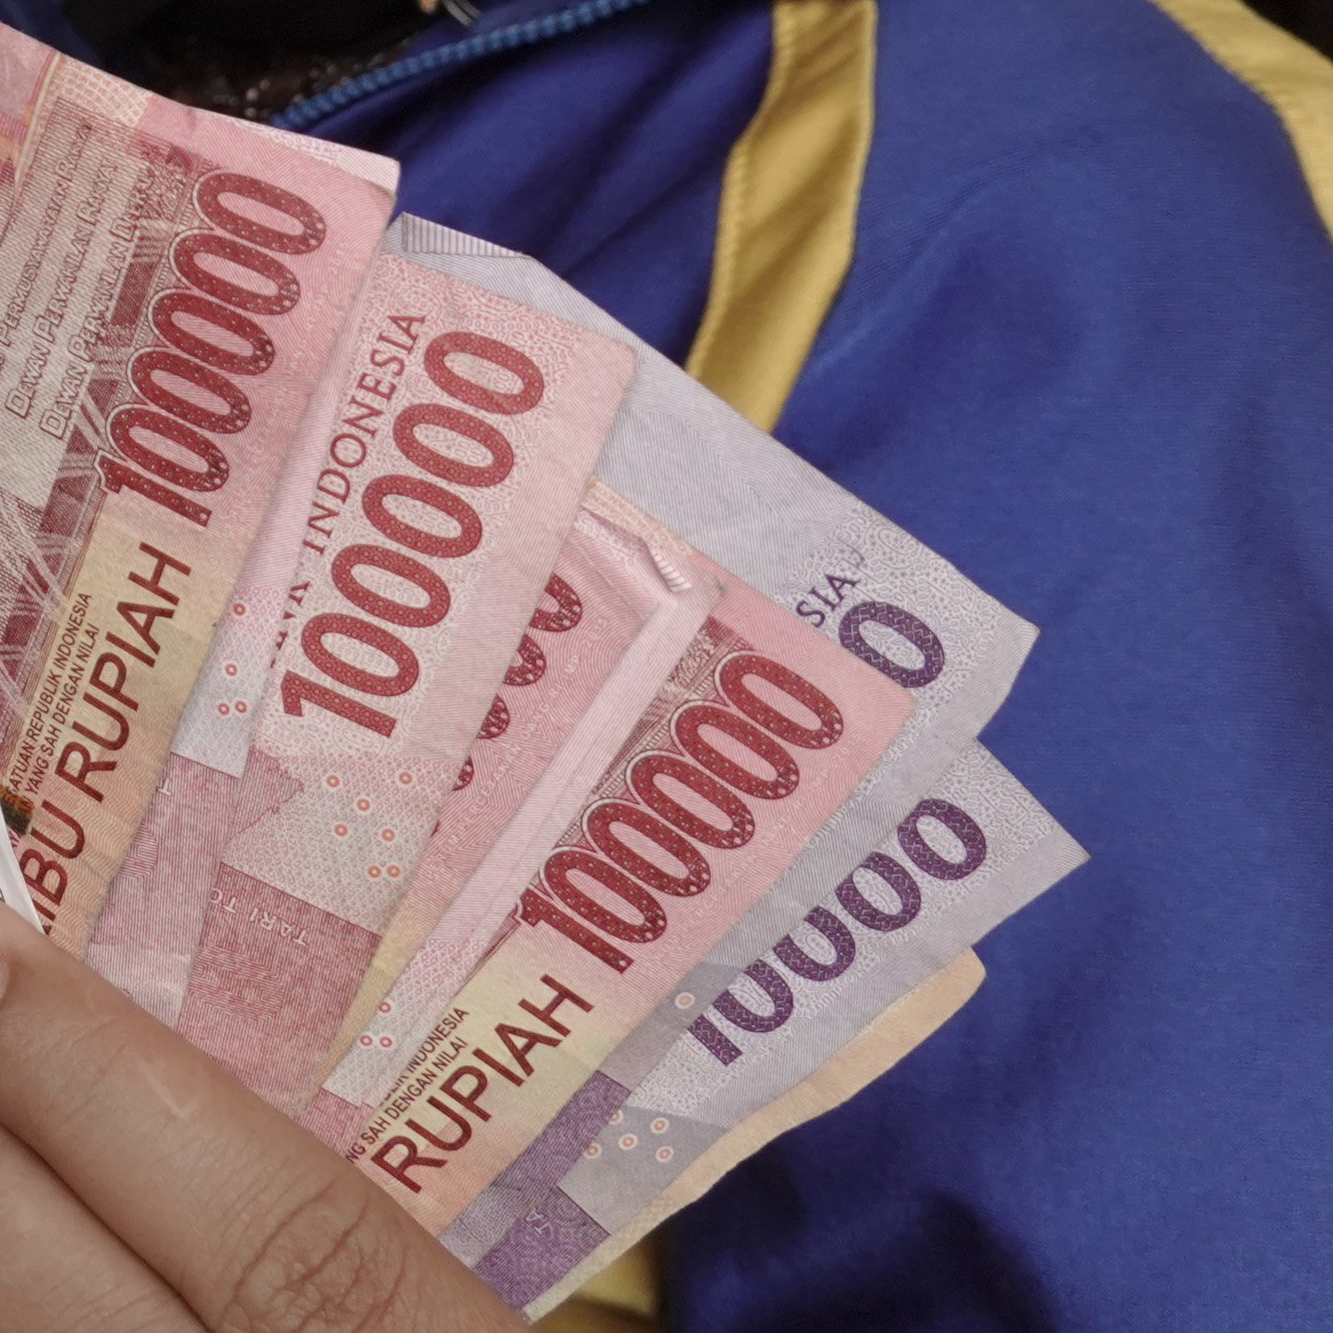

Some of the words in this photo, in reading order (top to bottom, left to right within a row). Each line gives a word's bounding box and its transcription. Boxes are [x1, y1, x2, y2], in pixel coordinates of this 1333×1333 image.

[5, 344, 51, 419] DEWAN
[34, 225, 90, 344] PERWAKILAN
[39, 364, 88, 441] DEWAN
[68, 243, 128, 362] PERWAKILAN
[94, 169, 326, 527] 100000
[280, 331, 545, 738] 100000
[303, 315, 426, 555] INDONESIA
[20, 799, 85, 935] IBU
[54, 539, 192, 804] RUPIAH
[25, 756, 50, 796] YANG
[40, 726, 62, 757] SAH
[57, 669, 84, 727] DENGAN
[76, 625, 101, 670] NILAI
[26, 670, 62, 743] REPUBLIK
[53, 592, 92, 670] INDONESIA
[517, 650, 844, 974] 100000
[360, 1115, 392, 1147] SAH
[384, 1069, 437, 1122] DENGAN
[436, 1036, 469, 1074] NILAI
[370, 973, 595, 1194] RUPIAH
[407, 1006, 470, 1076] INDONESIA
